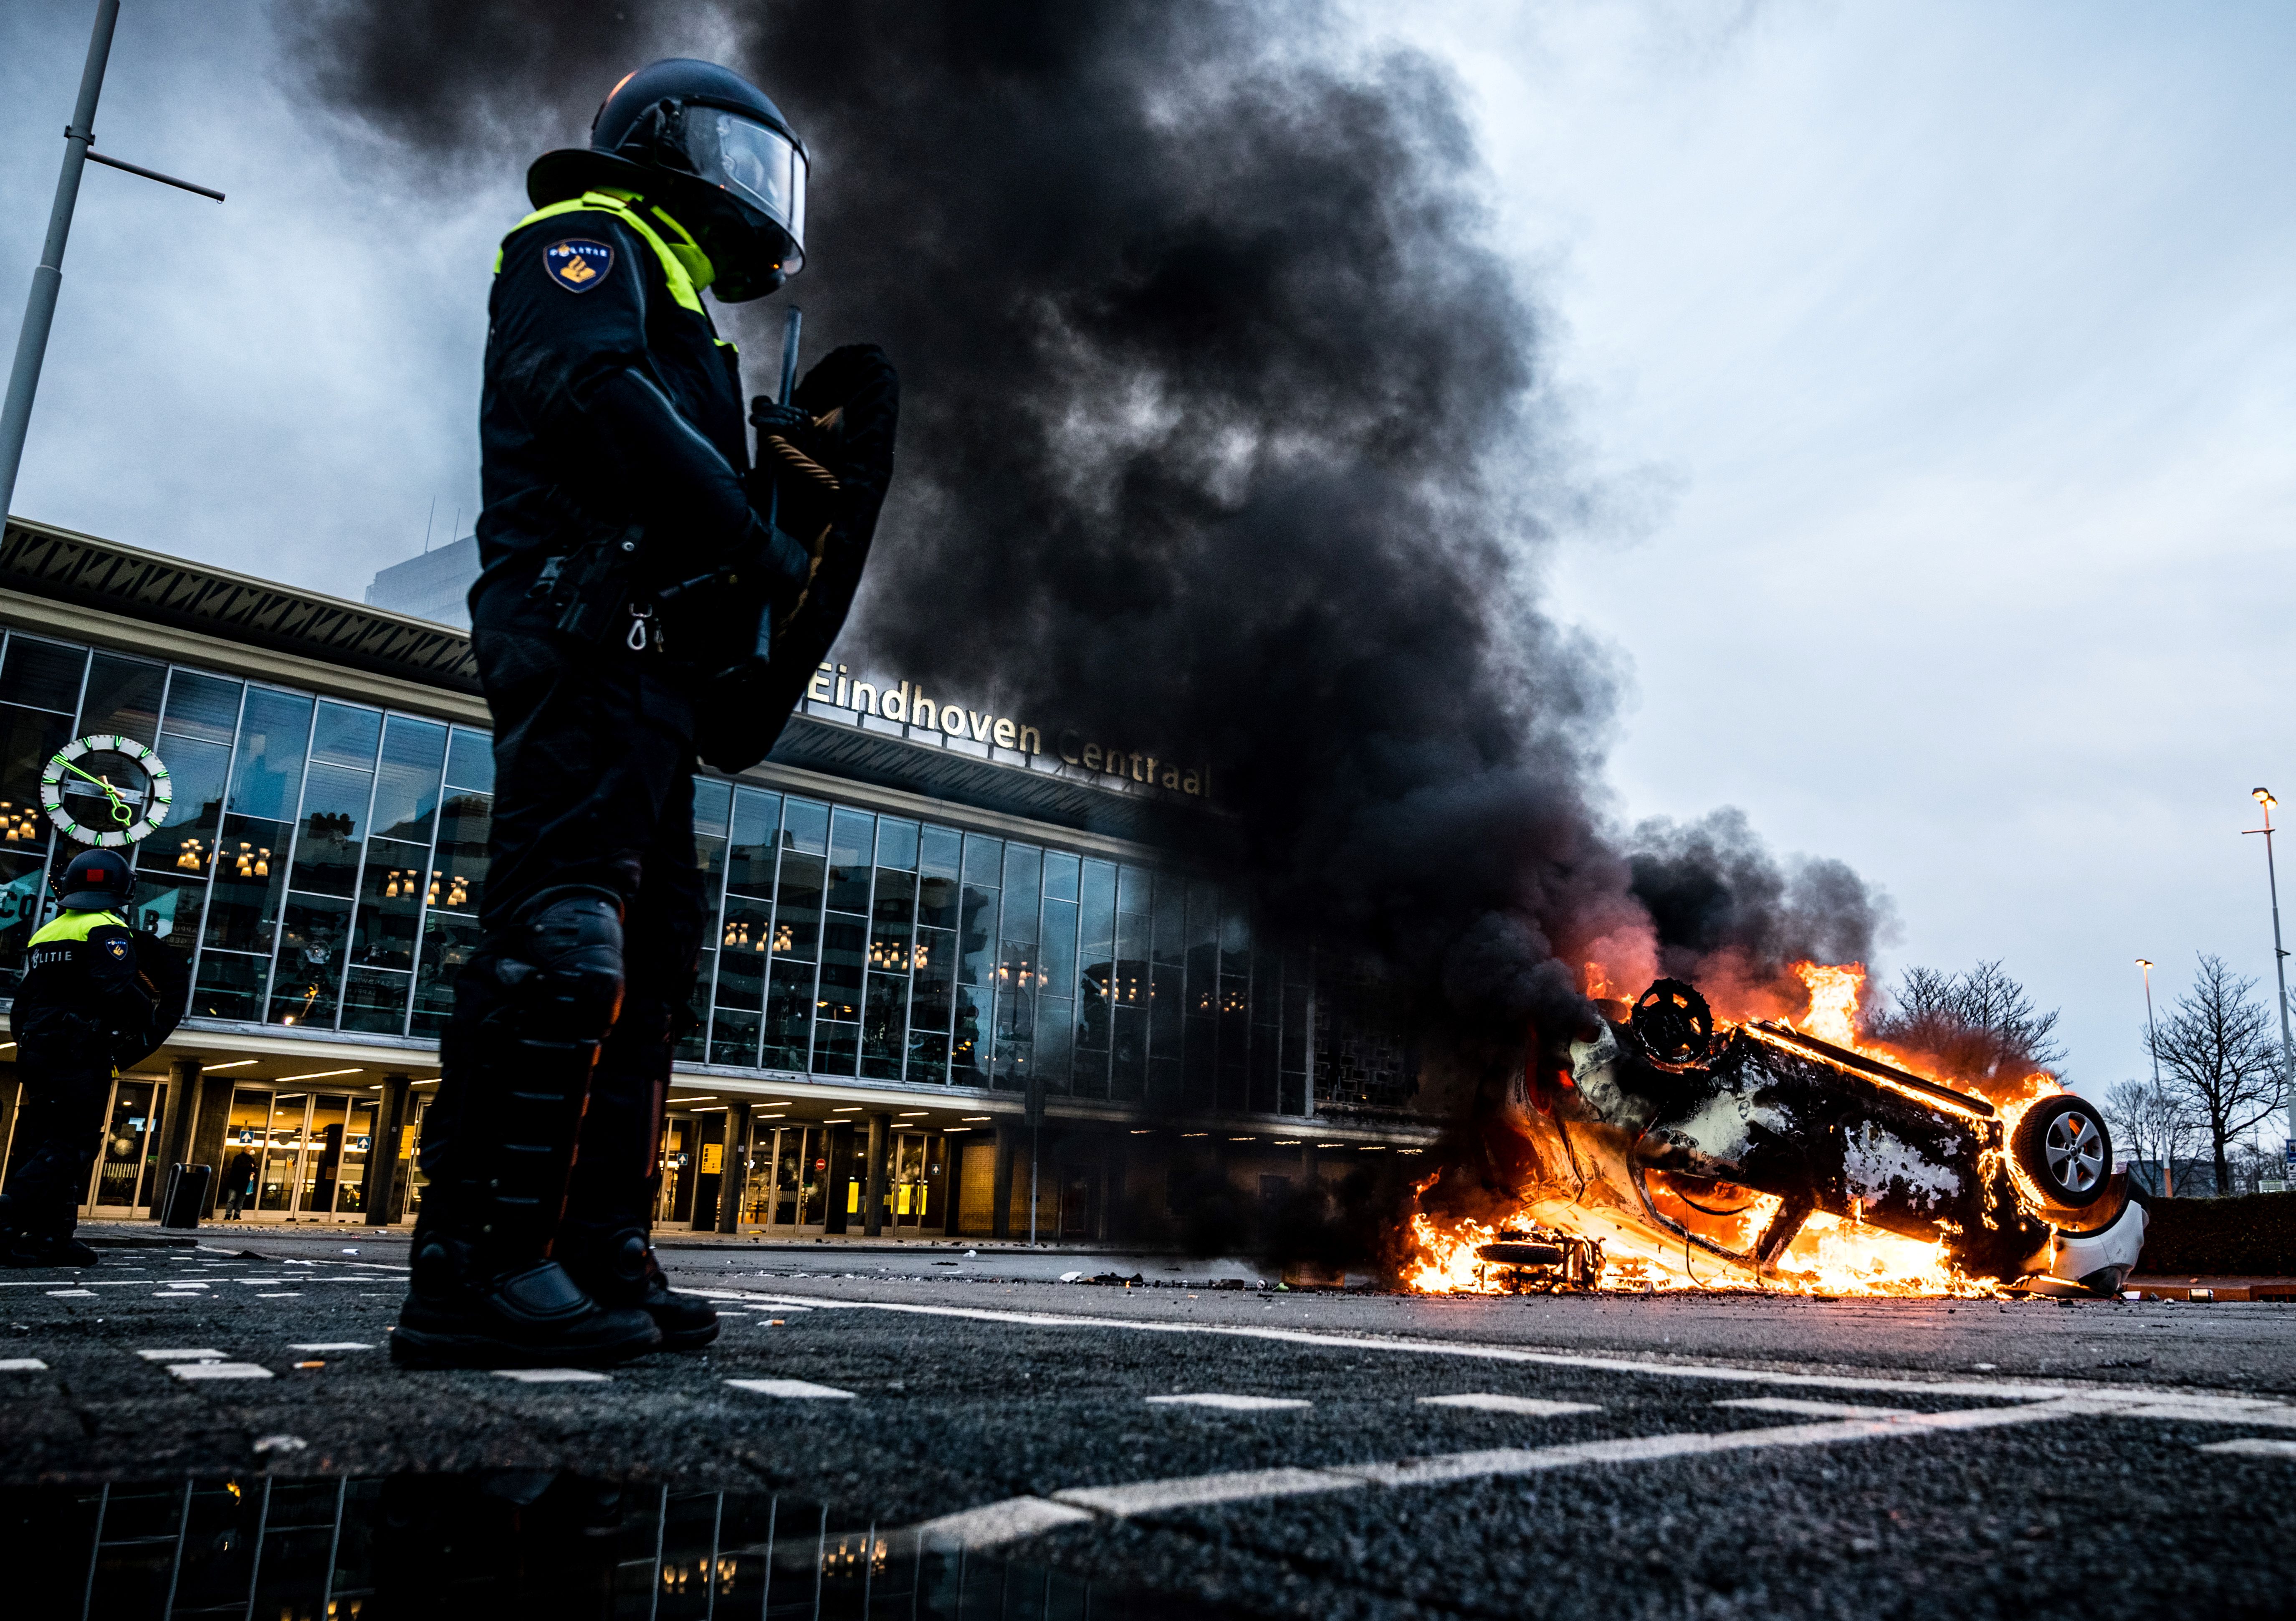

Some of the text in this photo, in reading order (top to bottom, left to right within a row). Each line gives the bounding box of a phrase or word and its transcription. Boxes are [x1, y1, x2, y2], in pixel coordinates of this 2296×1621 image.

[549, 246, 607, 257] POLITIE
[807, 662, 1211, 797] Eindhoven Centraal
